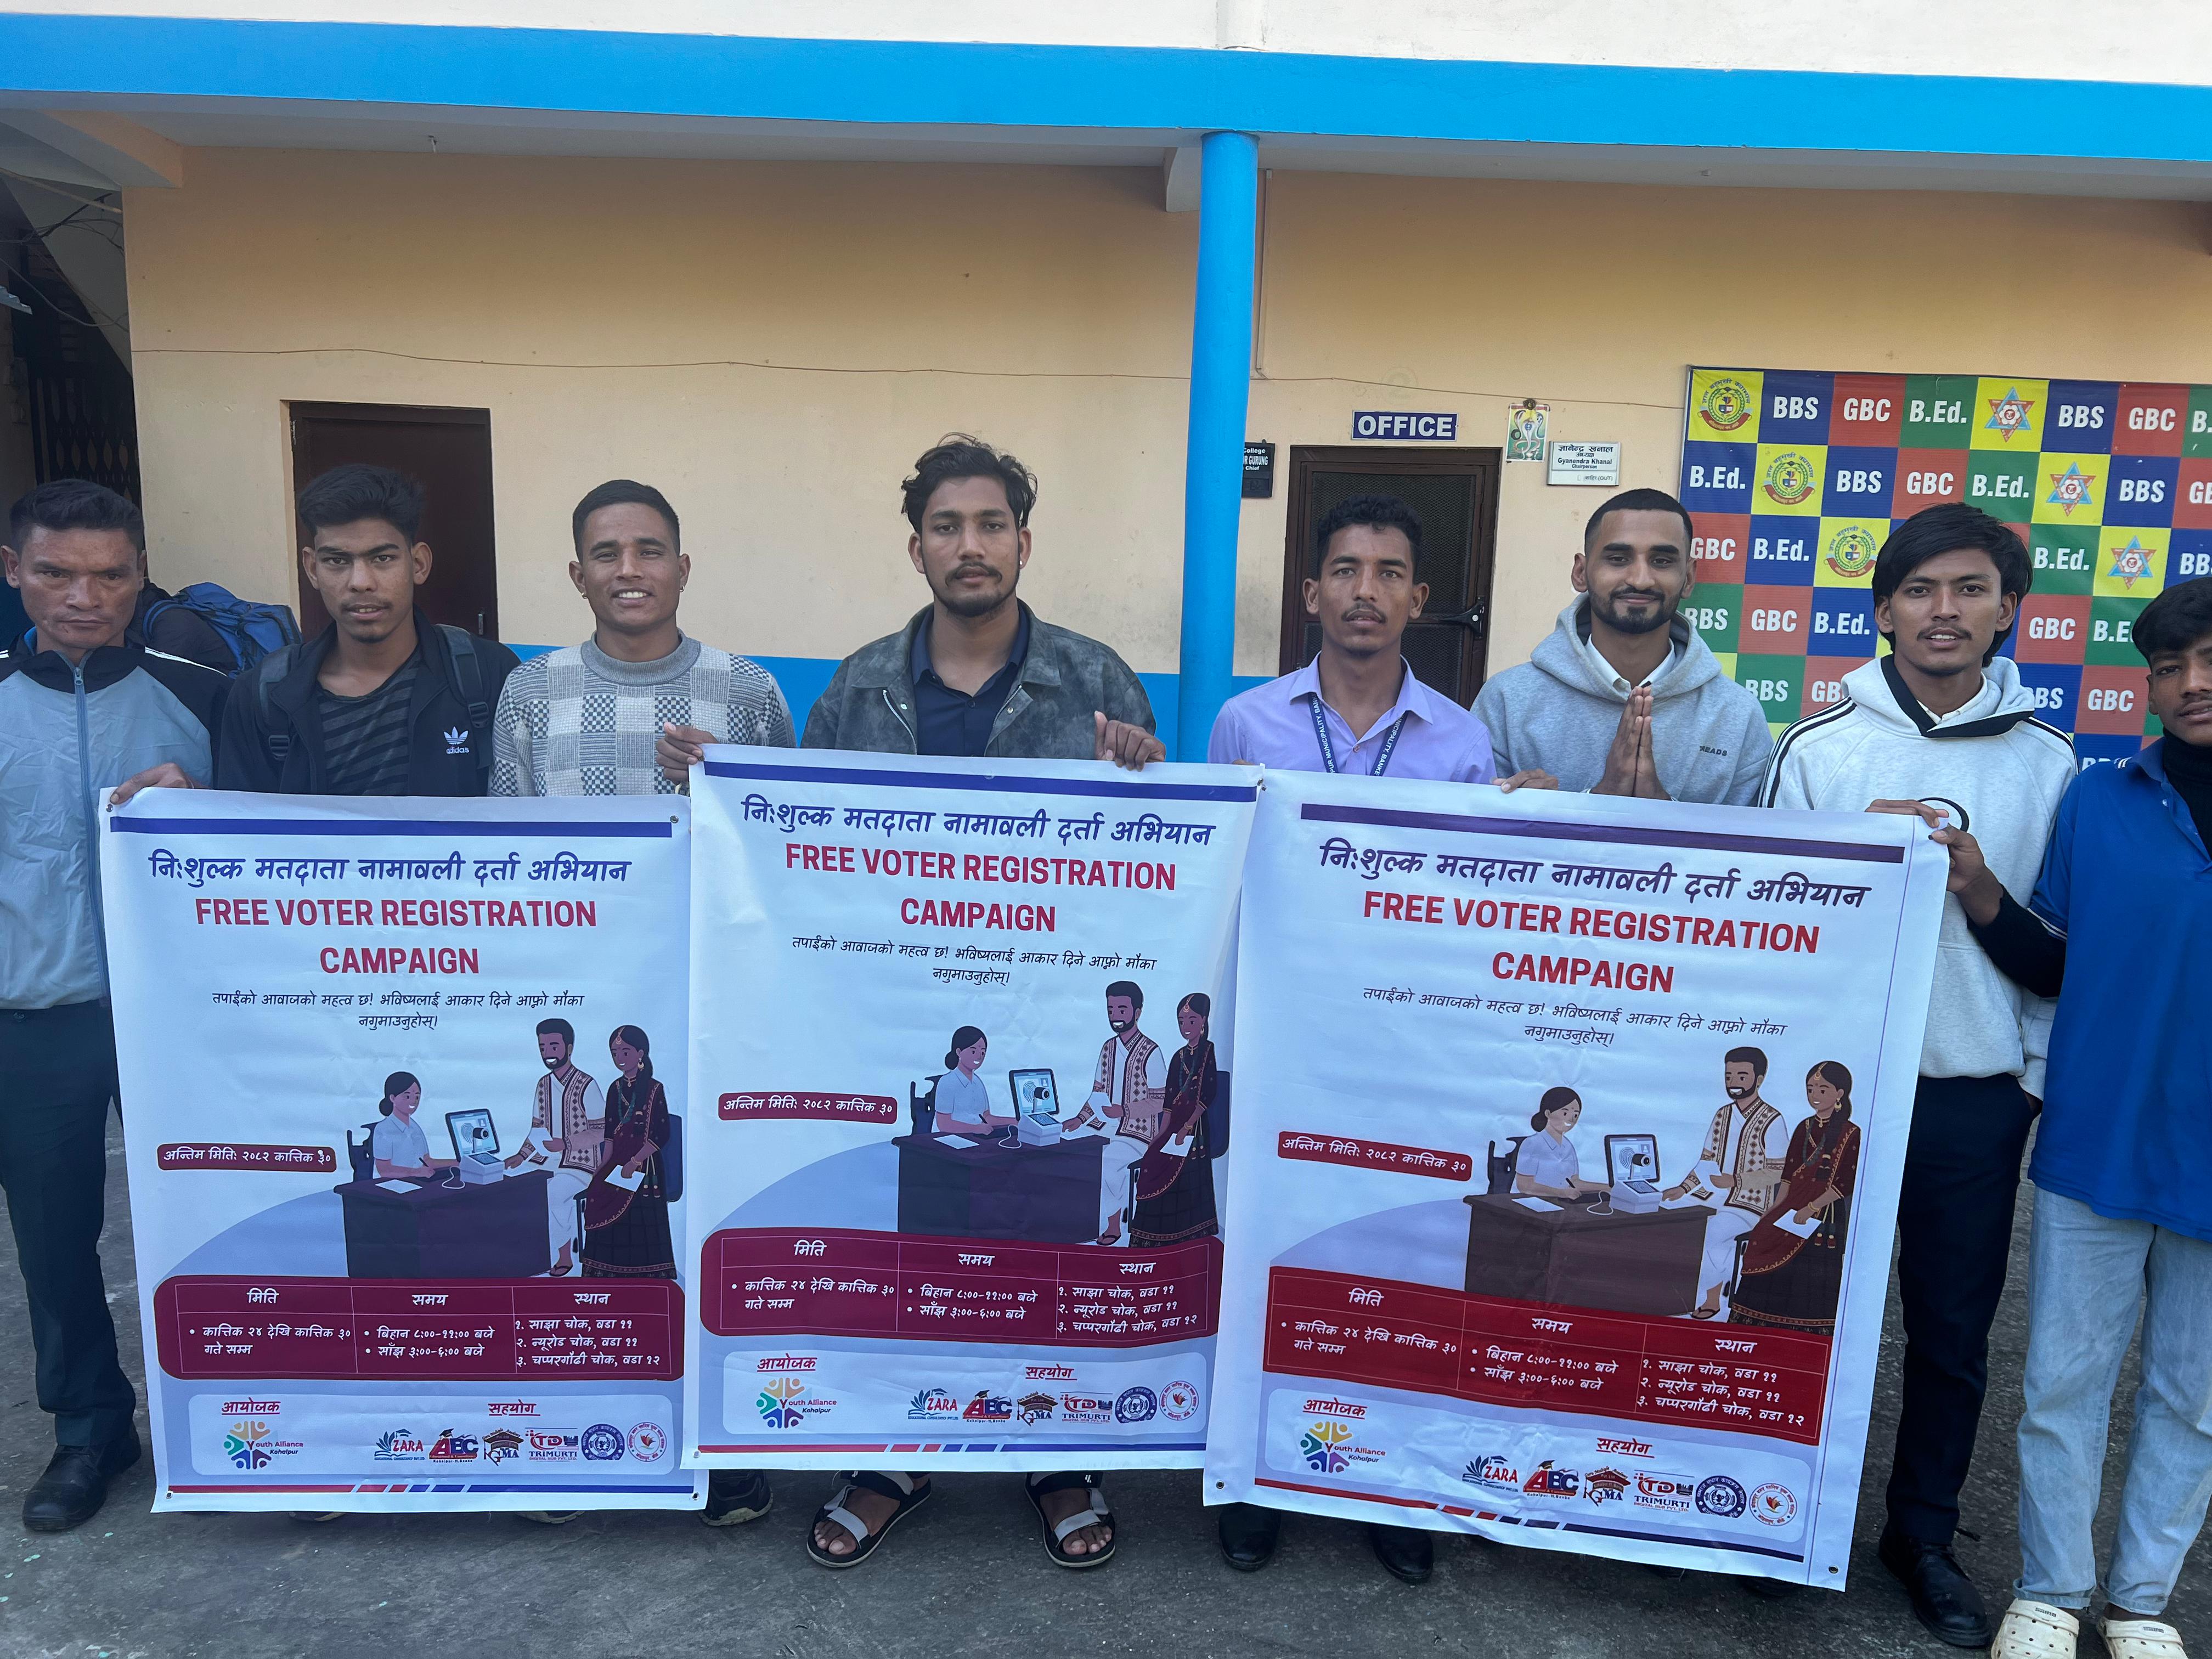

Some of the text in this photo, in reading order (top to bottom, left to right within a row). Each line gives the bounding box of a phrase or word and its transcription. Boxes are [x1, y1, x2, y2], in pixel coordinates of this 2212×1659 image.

[1774, 397, 1818, 419] BBS
[1844, 398, 1891, 421] GBC
[1910, 400, 1966, 423] B.Ed.
[2058, 405, 2104, 428] BBS
[1358, 416, 1452, 436] OFFICE
[2129, 408, 2175, 431] GBC
[1249, 455, 1268, 465] GURUNG
[1690, 466, 1745, 489] B.Ed.
[1837, 471, 1882, 493] BBS
[1907, 472, 1953, 495] GBC
[1972, 475, 2029, 498] B.Ed.
[2119, 479, 2165, 503] BBS
[2190, 482, 2212, 504] GB
[1690, 538, 1735, 561] GBC
[1754, 538, 1809, 561] B.Ed.
[2034, 548, 2089, 570] B.Ed.
[2180, 553, 2212, 575] BB
[1685, 608, 1728, 630] BBS
[1752, 610, 1797, 631] GBC
[1815, 612, 1870, 634] B.Ed.
[2029, 617, 2075, 640] GBC
[2094, 620, 2134, 642] B.E
[1745, 679, 1788, 702] BBS
[1812, 681, 1843, 703] GB
[2034, 687, 2064, 709] BS
[2088, 689, 2134, 712] GBC
[844, 808, 936, 837] मतदाता
[944, 809, 1050, 838] नामावली
[1058, 812, 1105, 846] दर्ता
[1111, 814, 1216, 845] अभियान
[255, 859, 350, 887] मतदाता
[358, 851, 465, 880] नामावली
[473, 852, 521, 888] दर्ता
[528, 851, 632, 881] अभियान
[786, 843, 1175, 890] FREE VOTER REGISTRATION
[1437, 855, 1544, 887] मतदाता
[1551, 862, 1676, 894] नामावली
[1685, 868, 1741, 904] दर्ता
[1747, 872, 1872, 907] अभियान
[196, 899, 596, 927] FREE VOTER REGISTRATION
[901, 898, 1055, 932] CAMPAIGN
[1364, 891, 1819, 953] FREE VOTER REGISTRATION
[320, 947, 478, 973] CAMPAIGN
[1493, 952, 1674, 992] CAMPAIGN
[262, 990, 317, 1005] आवाजको
[321, 995, 354, 1007] महत्व
[358, 993, 373, 1005] छ!
[380, 991, 441, 1008] भविष्यलाई
[445, 996, 485, 1007] आकार
[489, 991, 512, 1008] दिने
[554, 990, 585, 1006] मौका
[724, 1096, 765, 1109] अन्तिम
[803, 1099, 830, 1110] २०८२
[879, 1104, 892, 1115] ३०
[164, 1146, 205, 1160] अन्तिम
[242, 1152, 269, 1161] २०८२
[318, 1153, 330, 1164] ३०
[1283, 1136, 1326, 1152] अन्तिम
[1367, 1149, 1396, 1161] २०८२
[1451, 1161, 1466, 1172] ३०
[794, 1240, 827, 1256] मिति
[958, 1254, 995, 1266] समय
[1119, 1262, 1156, 1274] स्थान
[247, 1288, 279, 1304] मिति
[791, 1281, 806, 1290] २४
[811, 1277, 836, 1294] देखि
[882, 1285, 894, 1296] ३०
[920, 1284, 954, 1298] बिहान
[1018, 1290, 1038, 1302] बजे
[412, 1295, 448, 1305] समय
[574, 1294, 611, 1304] स्थान
[746, 1296, 794, 1309] गते सम्म
[920, 1301, 947, 1318] साँझ
[1006, 1306, 1026, 1319] बजे
[1715, 1339, 1757, 1353] स्थान
[1659, 1361, 1695, 1374] साझा
[1699, 1362, 1728, 1379] चोक,
[1735, 1368, 1759, 1379] वडा
[1764, 1372, 1776, 1383] ११
[1658, 1378, 1697, 1395] न्यूरोड
[1701, 1380, 1730, 1398] चोक,
[1738, 1387, 1762, 1399] वडा
[1767, 1392, 1779, 1402] ११
[221, 1397, 281, 1413] आयोजक
[488, 1399, 537, 1414] सहयोग
[1304, 1397, 1367, 1417] आयोजक
[1722, 1402, 1752, 1420] चोक,
[1759, 1409, 1784, 1421] वडा
[1788, 1414, 1804, 1426] १२
[246, 1441, 273, 1449] Youth
[393, 1440, 424, 1452] ZARA
[430, 1438, 479, 1455] ABC
[1597, 1437, 1652, 1455] सहयोग
[1484, 1465, 1518, 1483] ZARA
[1523, 1470, 1579, 1492] ABC
[1634, 1496, 1690, 1508] TRIMURTI
